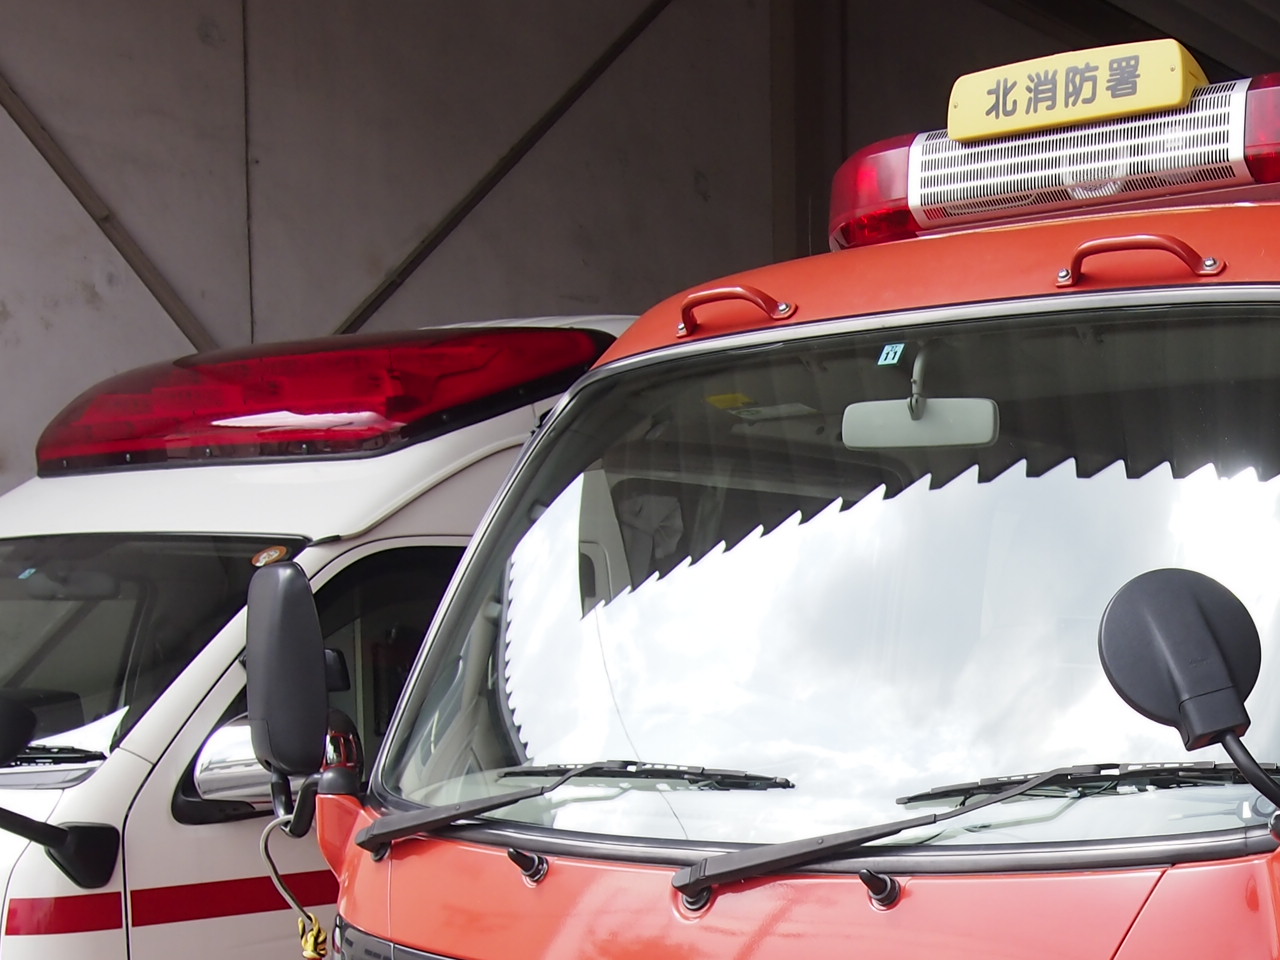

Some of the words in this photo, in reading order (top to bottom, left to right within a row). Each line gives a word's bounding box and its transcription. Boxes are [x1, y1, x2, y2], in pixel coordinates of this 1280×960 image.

[985, 54, 1141, 120] 北消防署
[883, 350, 898, 362] 11
